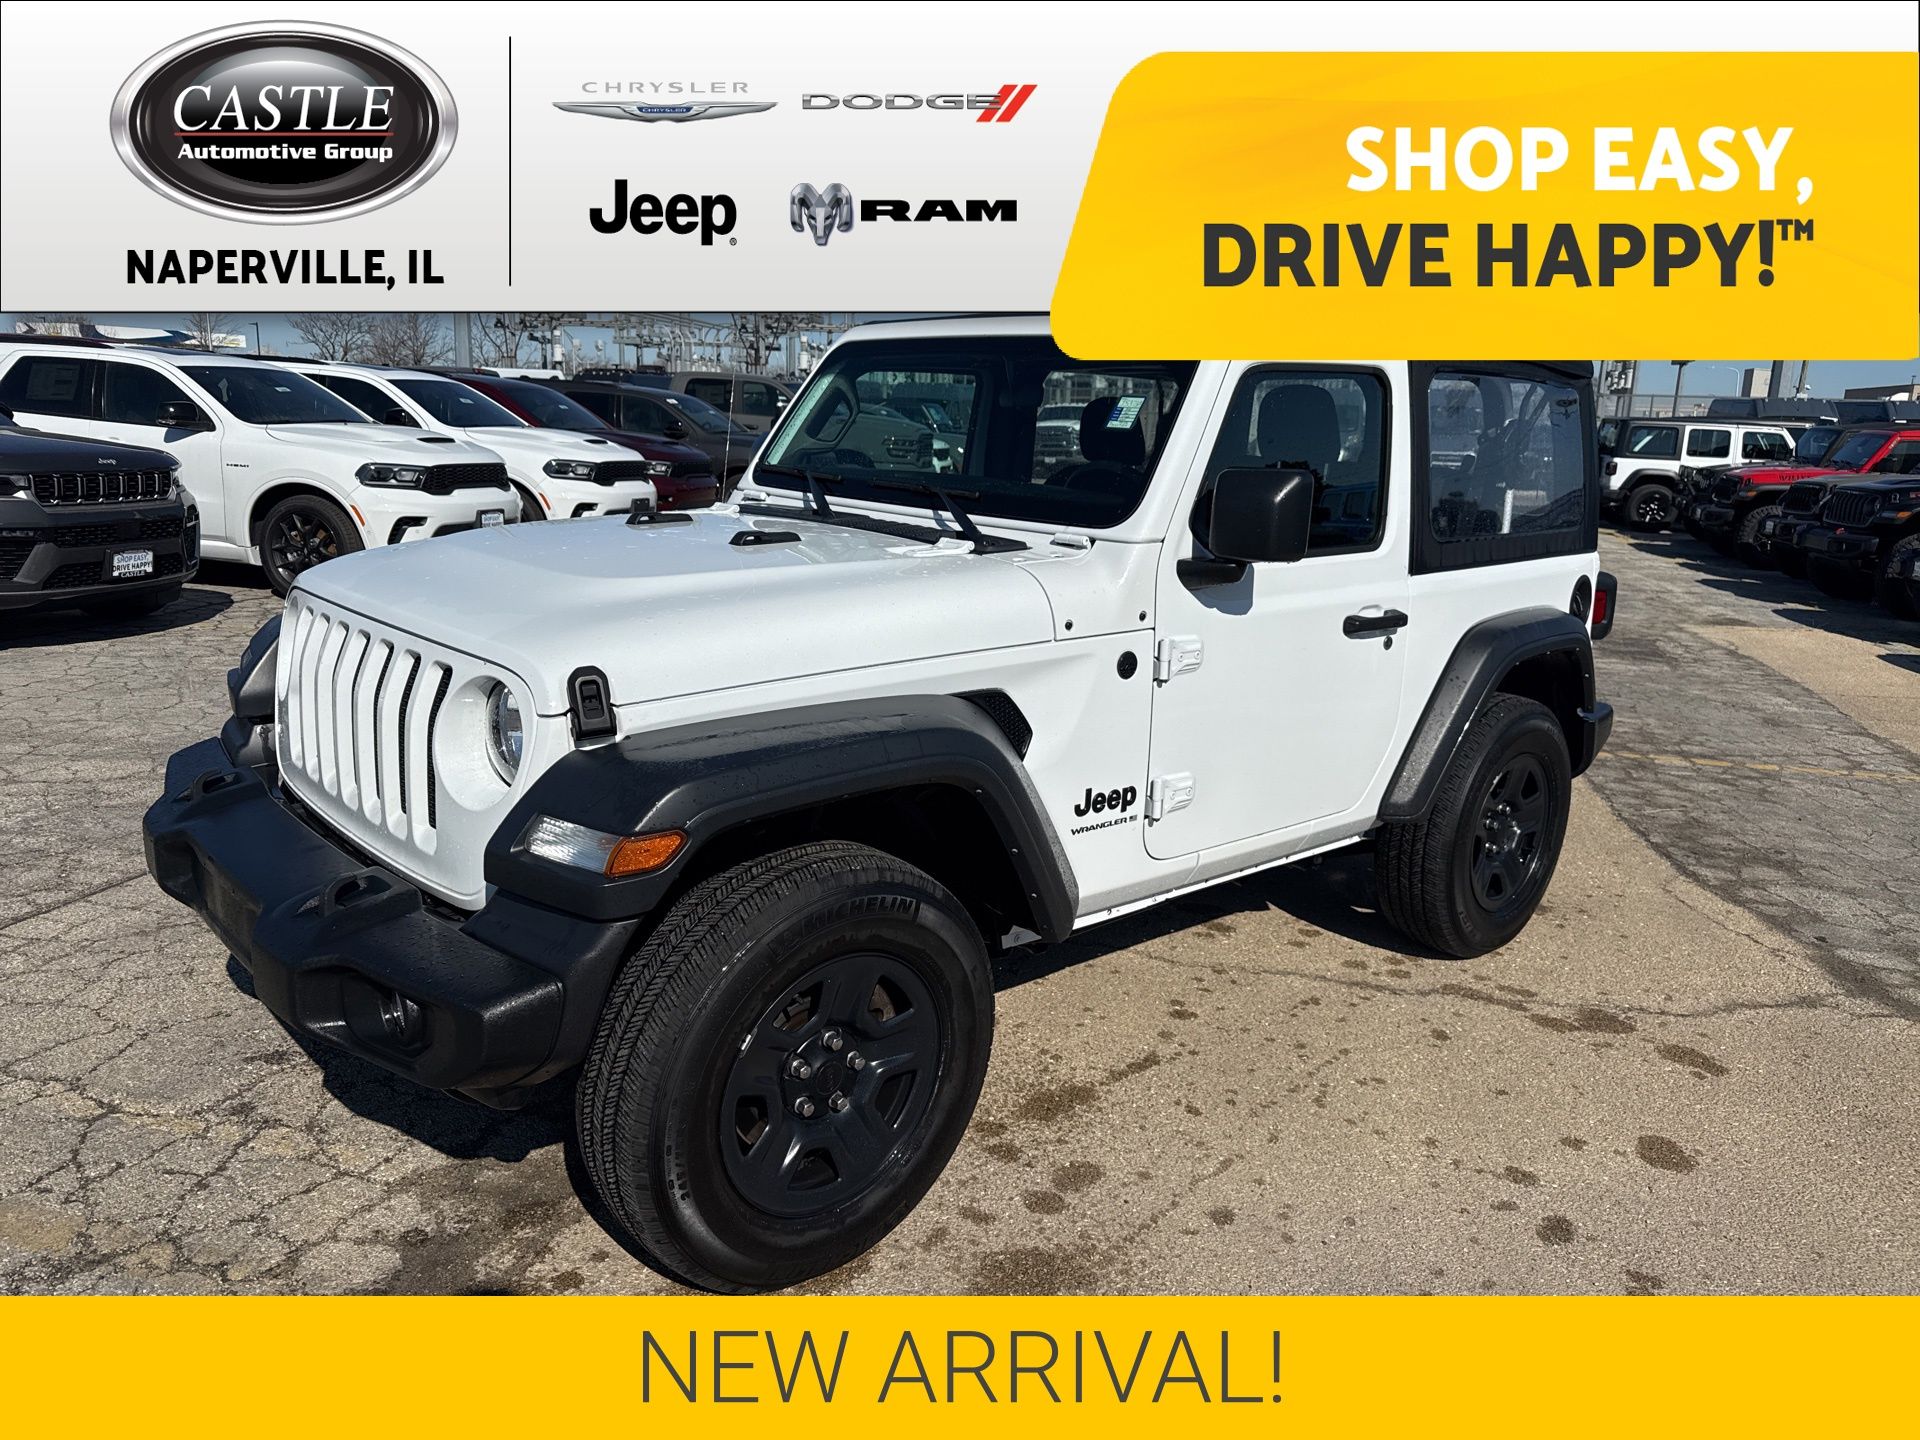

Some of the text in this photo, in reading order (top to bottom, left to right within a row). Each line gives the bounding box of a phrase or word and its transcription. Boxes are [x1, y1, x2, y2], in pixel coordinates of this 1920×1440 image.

[117, 556, 133, 564] SHOP
[113, 563, 131, 572] DRIVE
[120, 570, 146, 578] CASTLE
[1074, 785, 1137, 818] Jeep
[1070, 816, 1128, 836] WRANGLER
[801, 895, 916, 937] MICHELIN
